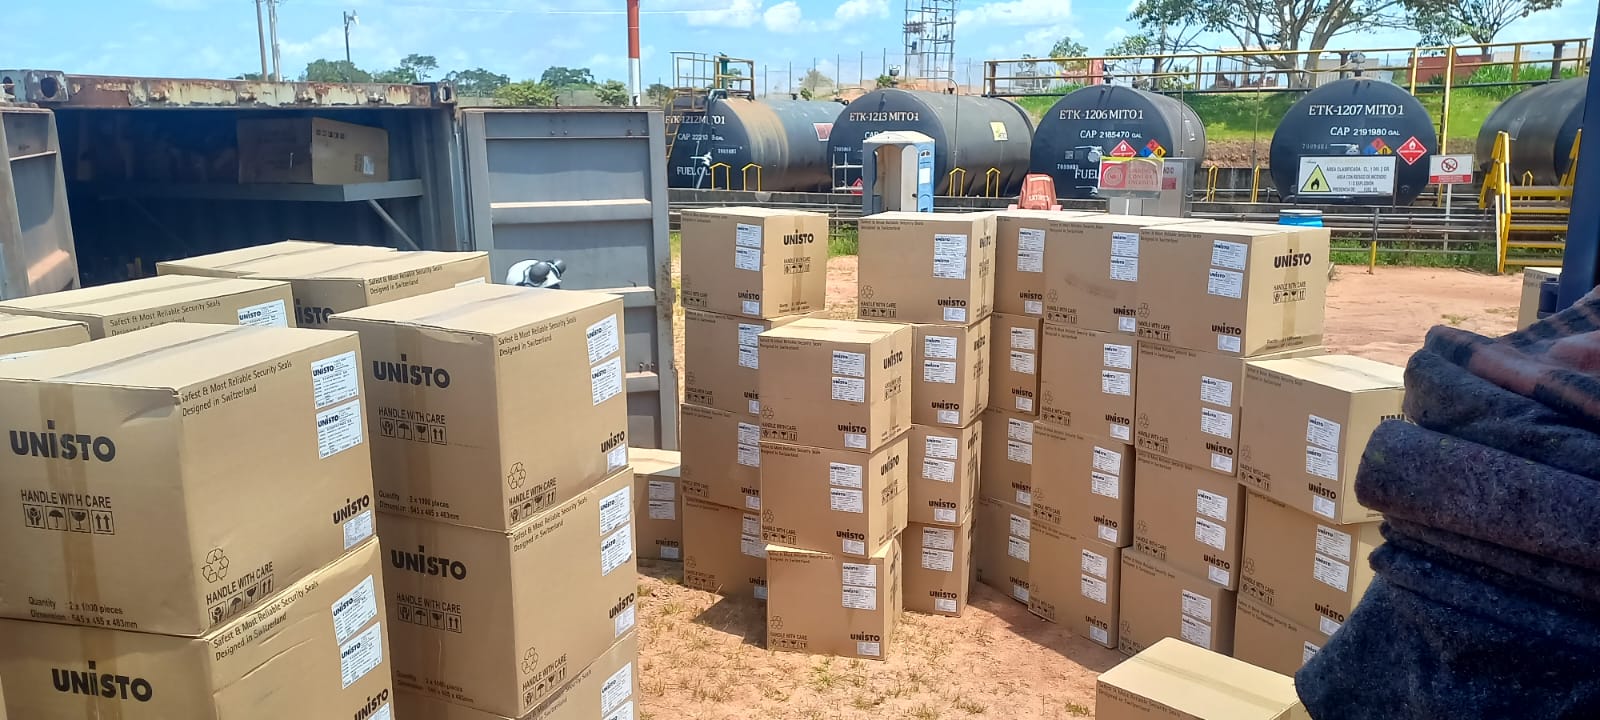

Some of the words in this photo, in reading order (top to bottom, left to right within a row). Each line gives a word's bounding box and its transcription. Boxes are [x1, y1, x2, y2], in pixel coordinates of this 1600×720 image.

[1309, 105, 1363, 115] ETK-1207
[1364, 105, 1404, 115] MITO1
[1080, 130, 1097, 138] CAP
[1330, 127, 1350, 135] CAP
[1075, 169, 1098, 179] FUEL
[110, 317, 130, 327] Safest
[139, 313, 155, 322] Most
[157, 308, 180, 318] Reliable
[182, 304, 205, 313] Security
[206, 300, 220, 308] Seals
[498, 336, 513, 345] Safest
[519, 330, 531, 338] Most
[531, 325, 548, 335] Reliable
[549, 320, 565, 330] Security
[499, 344, 520, 356] Designed
[527, 334, 552, 347] Switzerland
[203, 387, 208, 395] &
[210, 382, 226, 393] Most
[228, 373, 251, 386] Reliable
[253, 366, 276, 378] Security
[278, 360, 292, 371] Seals
[183, 398, 211, 416] Designed
[213, 397, 219, 406] in
[221, 384, 256, 403] Switzerland
[378, 407, 406, 421] HANDLE
[408, 409, 425, 422] WITH
[426, 413, 445, 424] CARE
[21, 489, 57, 505] HANDLE
[59, 492, 83, 507] WITH
[85, 495, 111, 508] CARE
[509, 489, 529, 506] HANDLE
[530, 484, 542, 496] WITH
[543, 477, 556, 490] CARE
[206, 581, 237, 605] HANDLE
[238, 572, 254, 589] WITH
[256, 561, 273, 579] CARE
[28, 597, 56, 609] Quantity
[100, 605, 123, 614] pieces
[397, 592, 421, 606] HANDLE
[423, 596, 439, 609] WITH
[440, 600, 461, 613] CARE
[214, 631, 234, 648] Safest
[235, 627, 241, 635] &
[242, 618, 257, 631] Most
[258, 603, 281, 621] Reliable
[281, 590, 303, 607] Security
[305, 581, 318, 593] Seals
[216, 639, 244, 661] Designed
[246, 634, 252, 643] in
[523, 672, 542, 691] HANDLE
[543, 665, 554, 677] WITH
[555, 653, 567, 668] CARE
